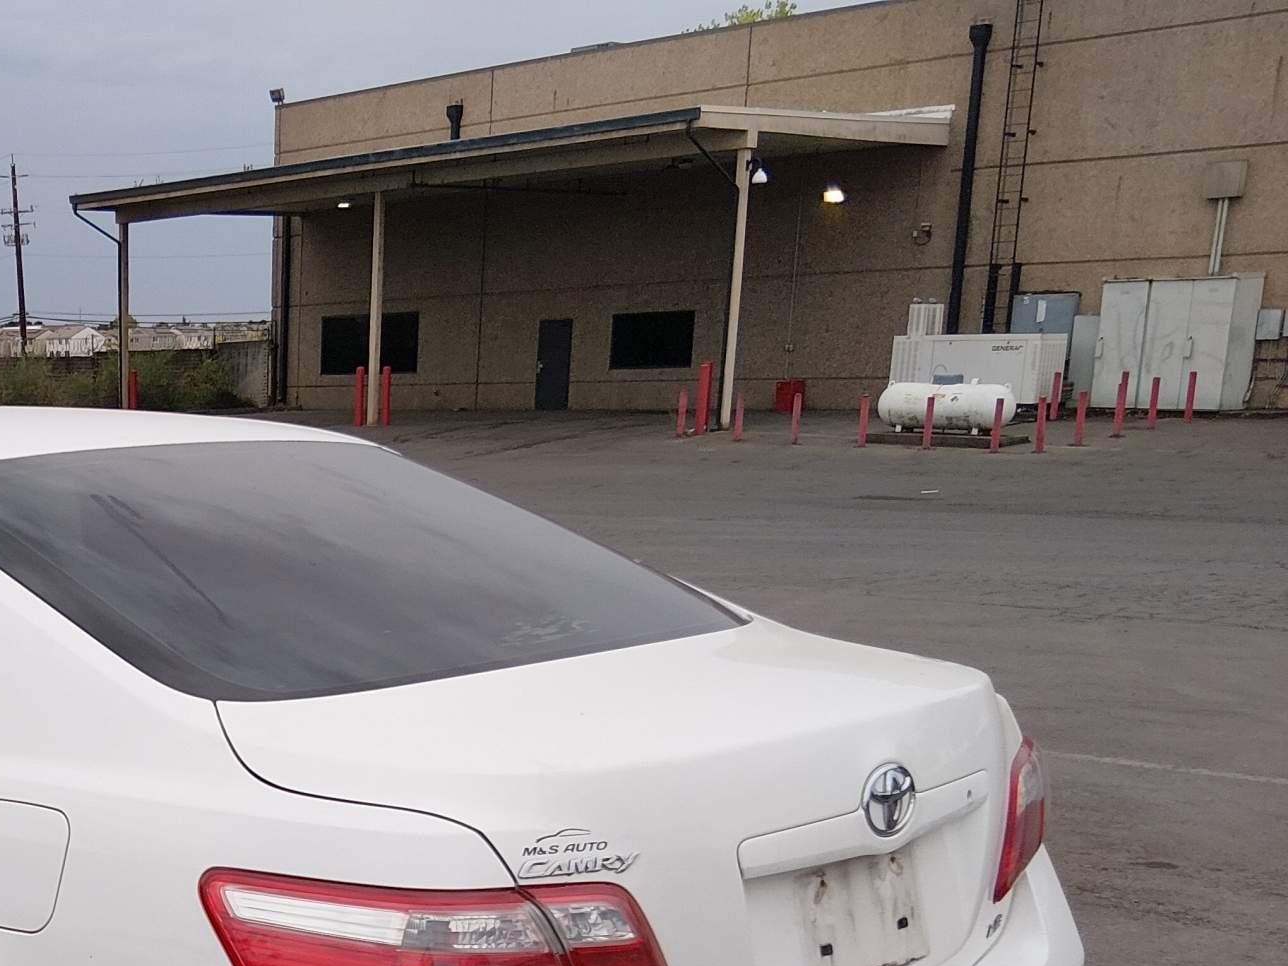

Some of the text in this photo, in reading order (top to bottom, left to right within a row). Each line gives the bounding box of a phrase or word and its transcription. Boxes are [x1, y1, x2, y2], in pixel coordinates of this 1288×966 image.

[522, 841, 608, 857] M&S AUTO
[518, 851, 640, 879] CAMRY
